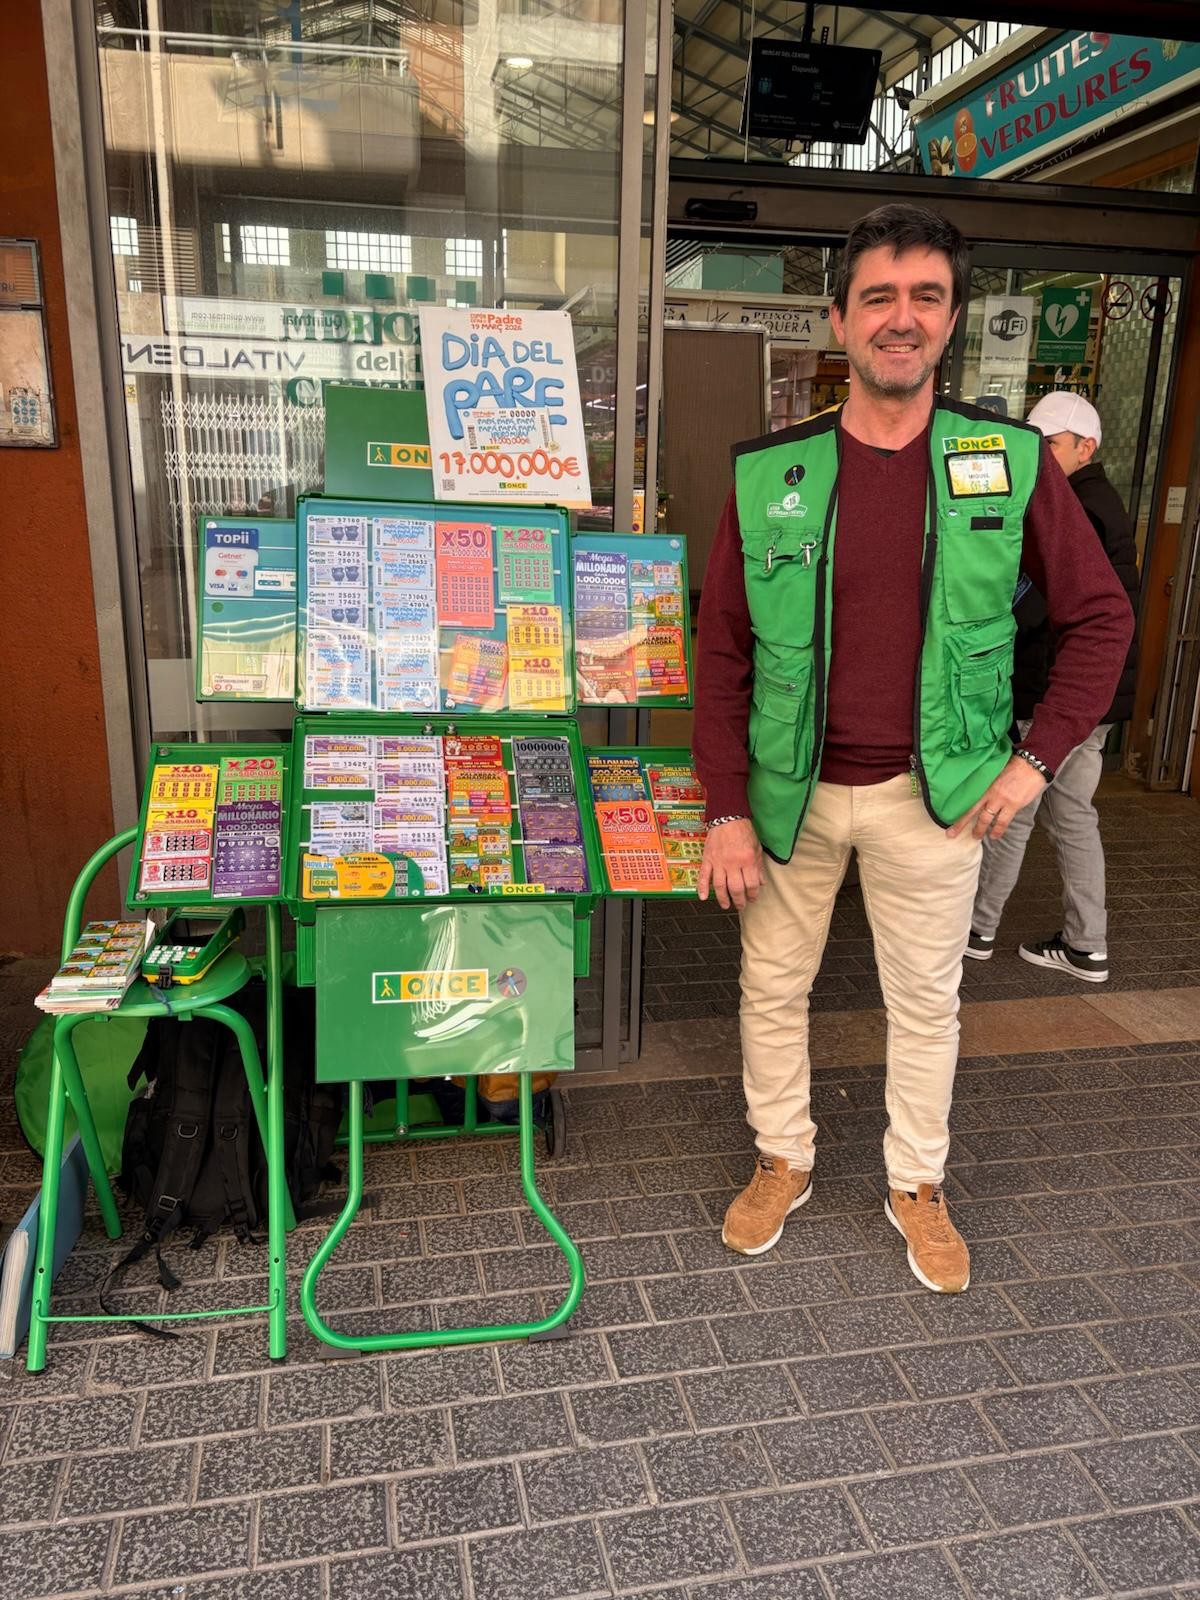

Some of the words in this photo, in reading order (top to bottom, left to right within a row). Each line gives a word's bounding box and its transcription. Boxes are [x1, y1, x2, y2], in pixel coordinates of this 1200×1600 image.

[985, 31, 1110, 117] FRUITES
[980, 47, 1152, 160] VERDURES
[487, 314, 523, 325] Padre
[753, 312, 800, 321] PEIXOS
[512, 340, 563, 365] DEL
[960, 437, 1001, 450] ONCE
[439, 449, 581, 480] 17.000.000€
[442, 529, 486, 548] x50
[503, 528, 545, 542] x20
[218, 552, 243, 560] Getnet
[590, 553, 613, 563] Mega
[576, 561, 626, 574] MILLONARIO
[576, 576, 626, 585] 1.000.000€
[522, 606, 549, 616] x10
[524, 658, 551, 668] x10
[171, 765, 203, 773] x10
[227, 758, 277, 770] x20
[235, 801, 264, 812] Mega
[165, 809, 198, 818] x10
[218, 811, 280, 822] MILLONARIO
[602, 807, 649, 825] x50
[218, 822, 280, 832] 1.000.000€
[505, 886, 541, 894] ONCE
[407, 975, 481, 995] ONCE
